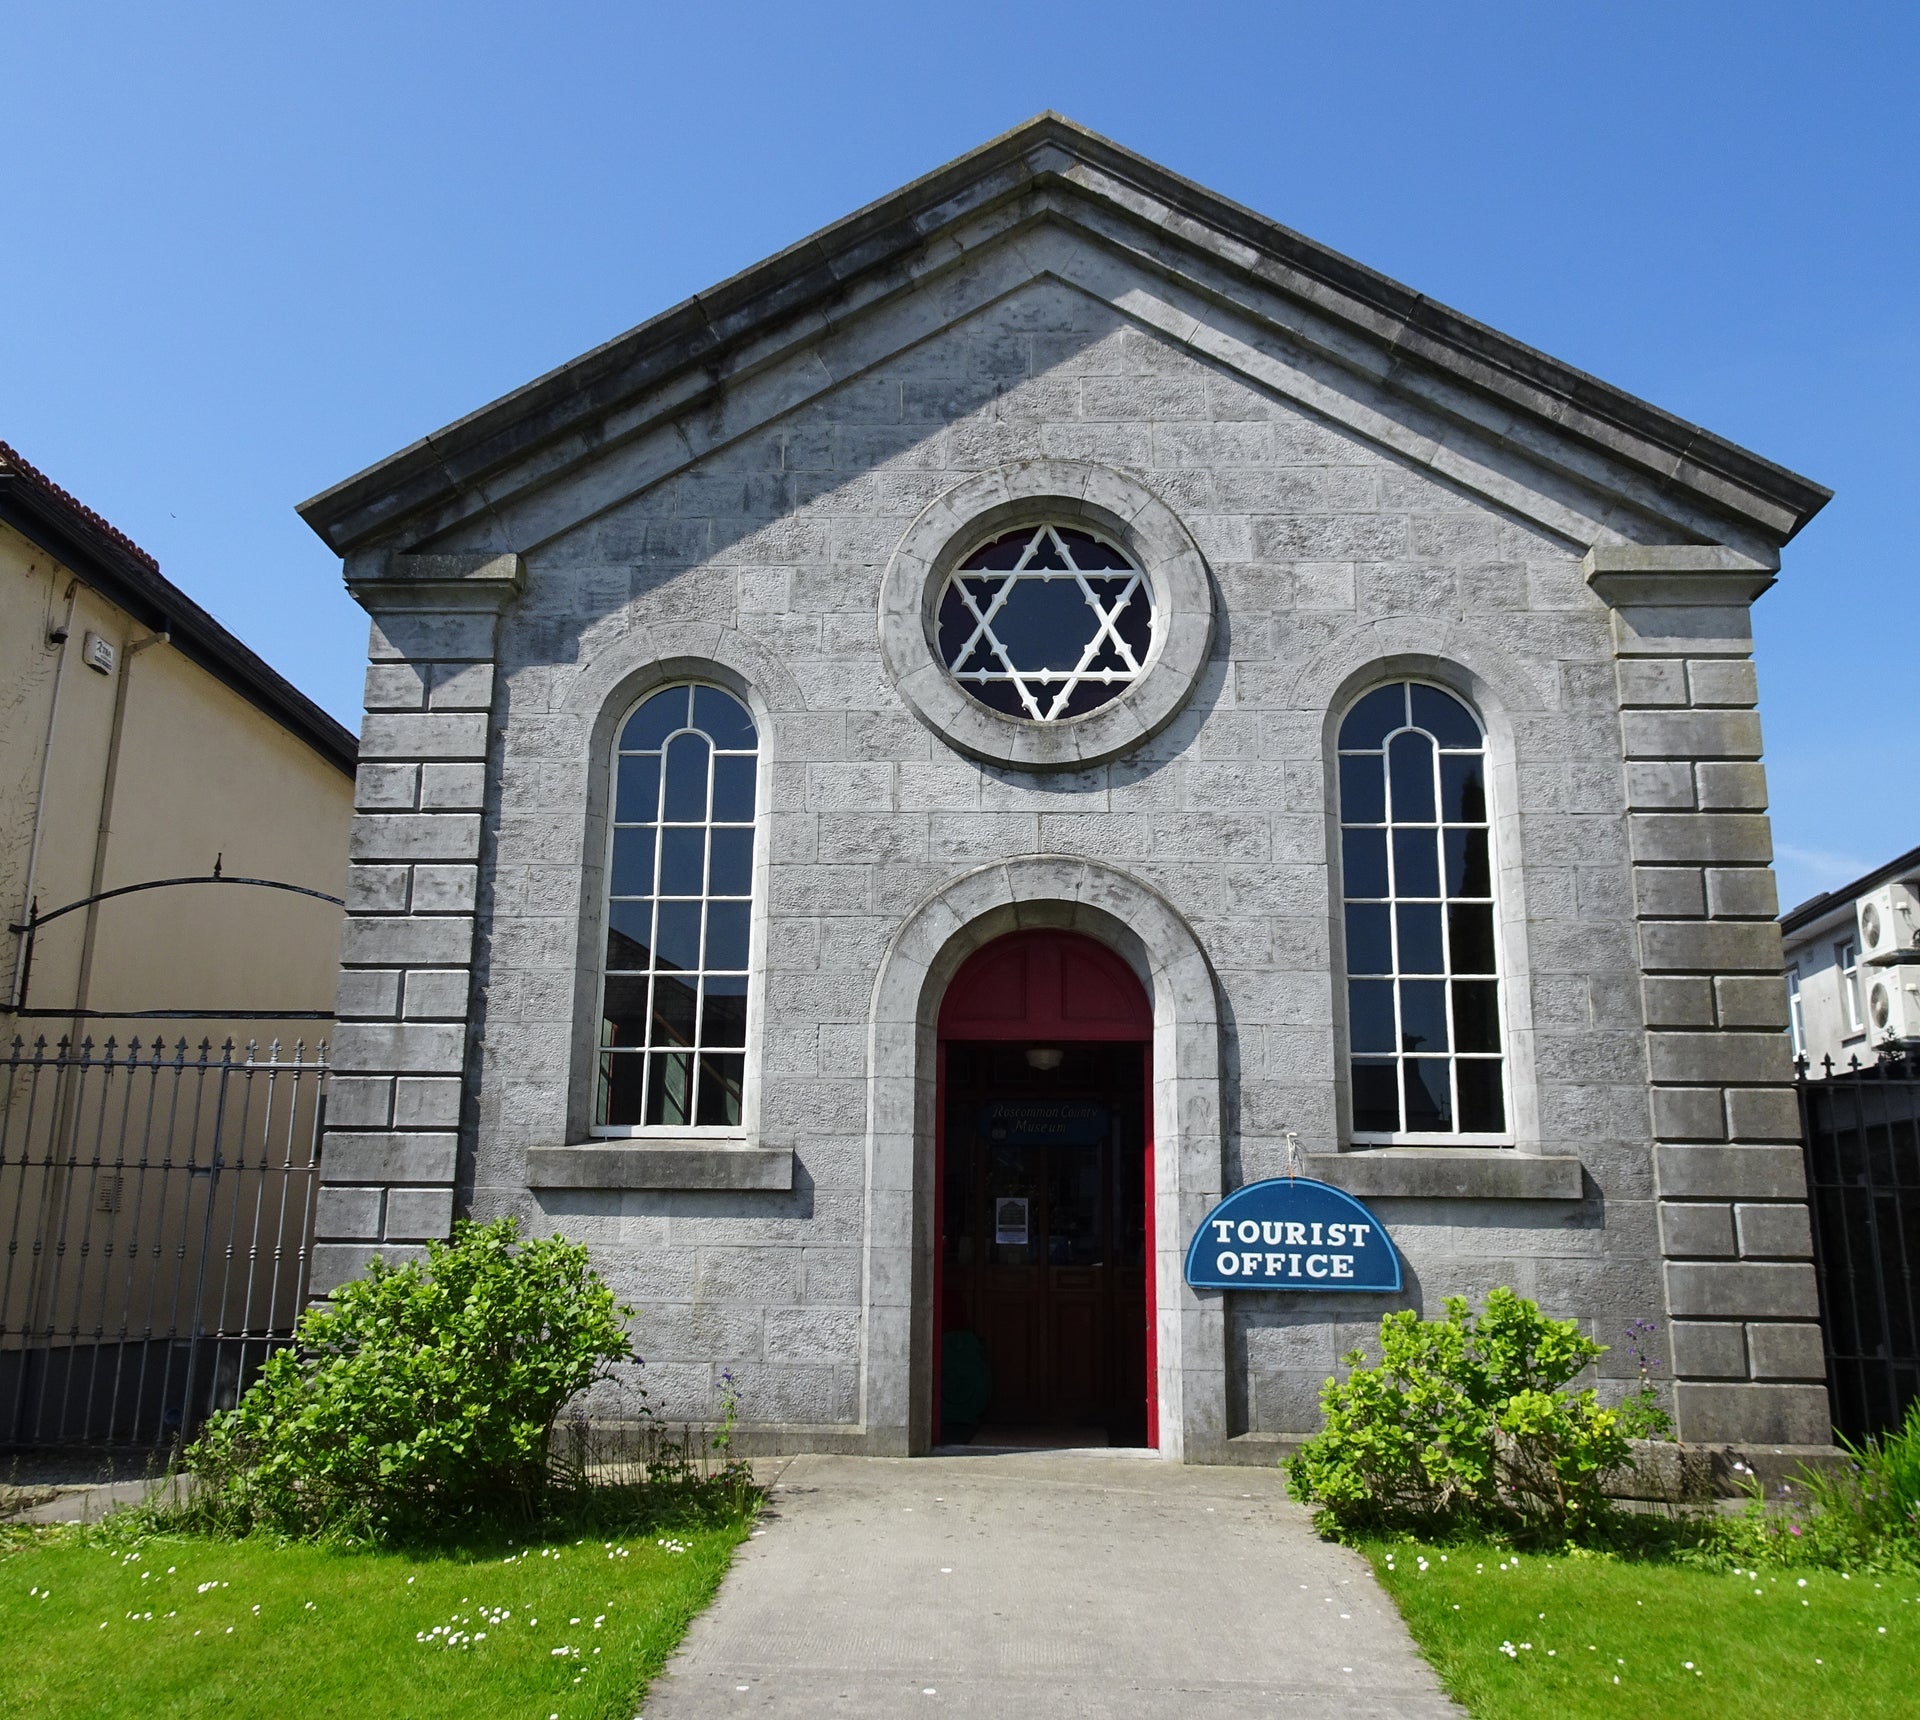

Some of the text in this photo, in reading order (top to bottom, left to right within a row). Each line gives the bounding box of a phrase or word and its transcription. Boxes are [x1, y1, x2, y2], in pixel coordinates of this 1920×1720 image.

[992, 1104, 1098, 1119] Roscommon County
[1014, 1119, 1067, 1134] Museum
[1212, 1220, 1370, 1247] TOURIST
[1216, 1251, 1354, 1278] OFFICE
